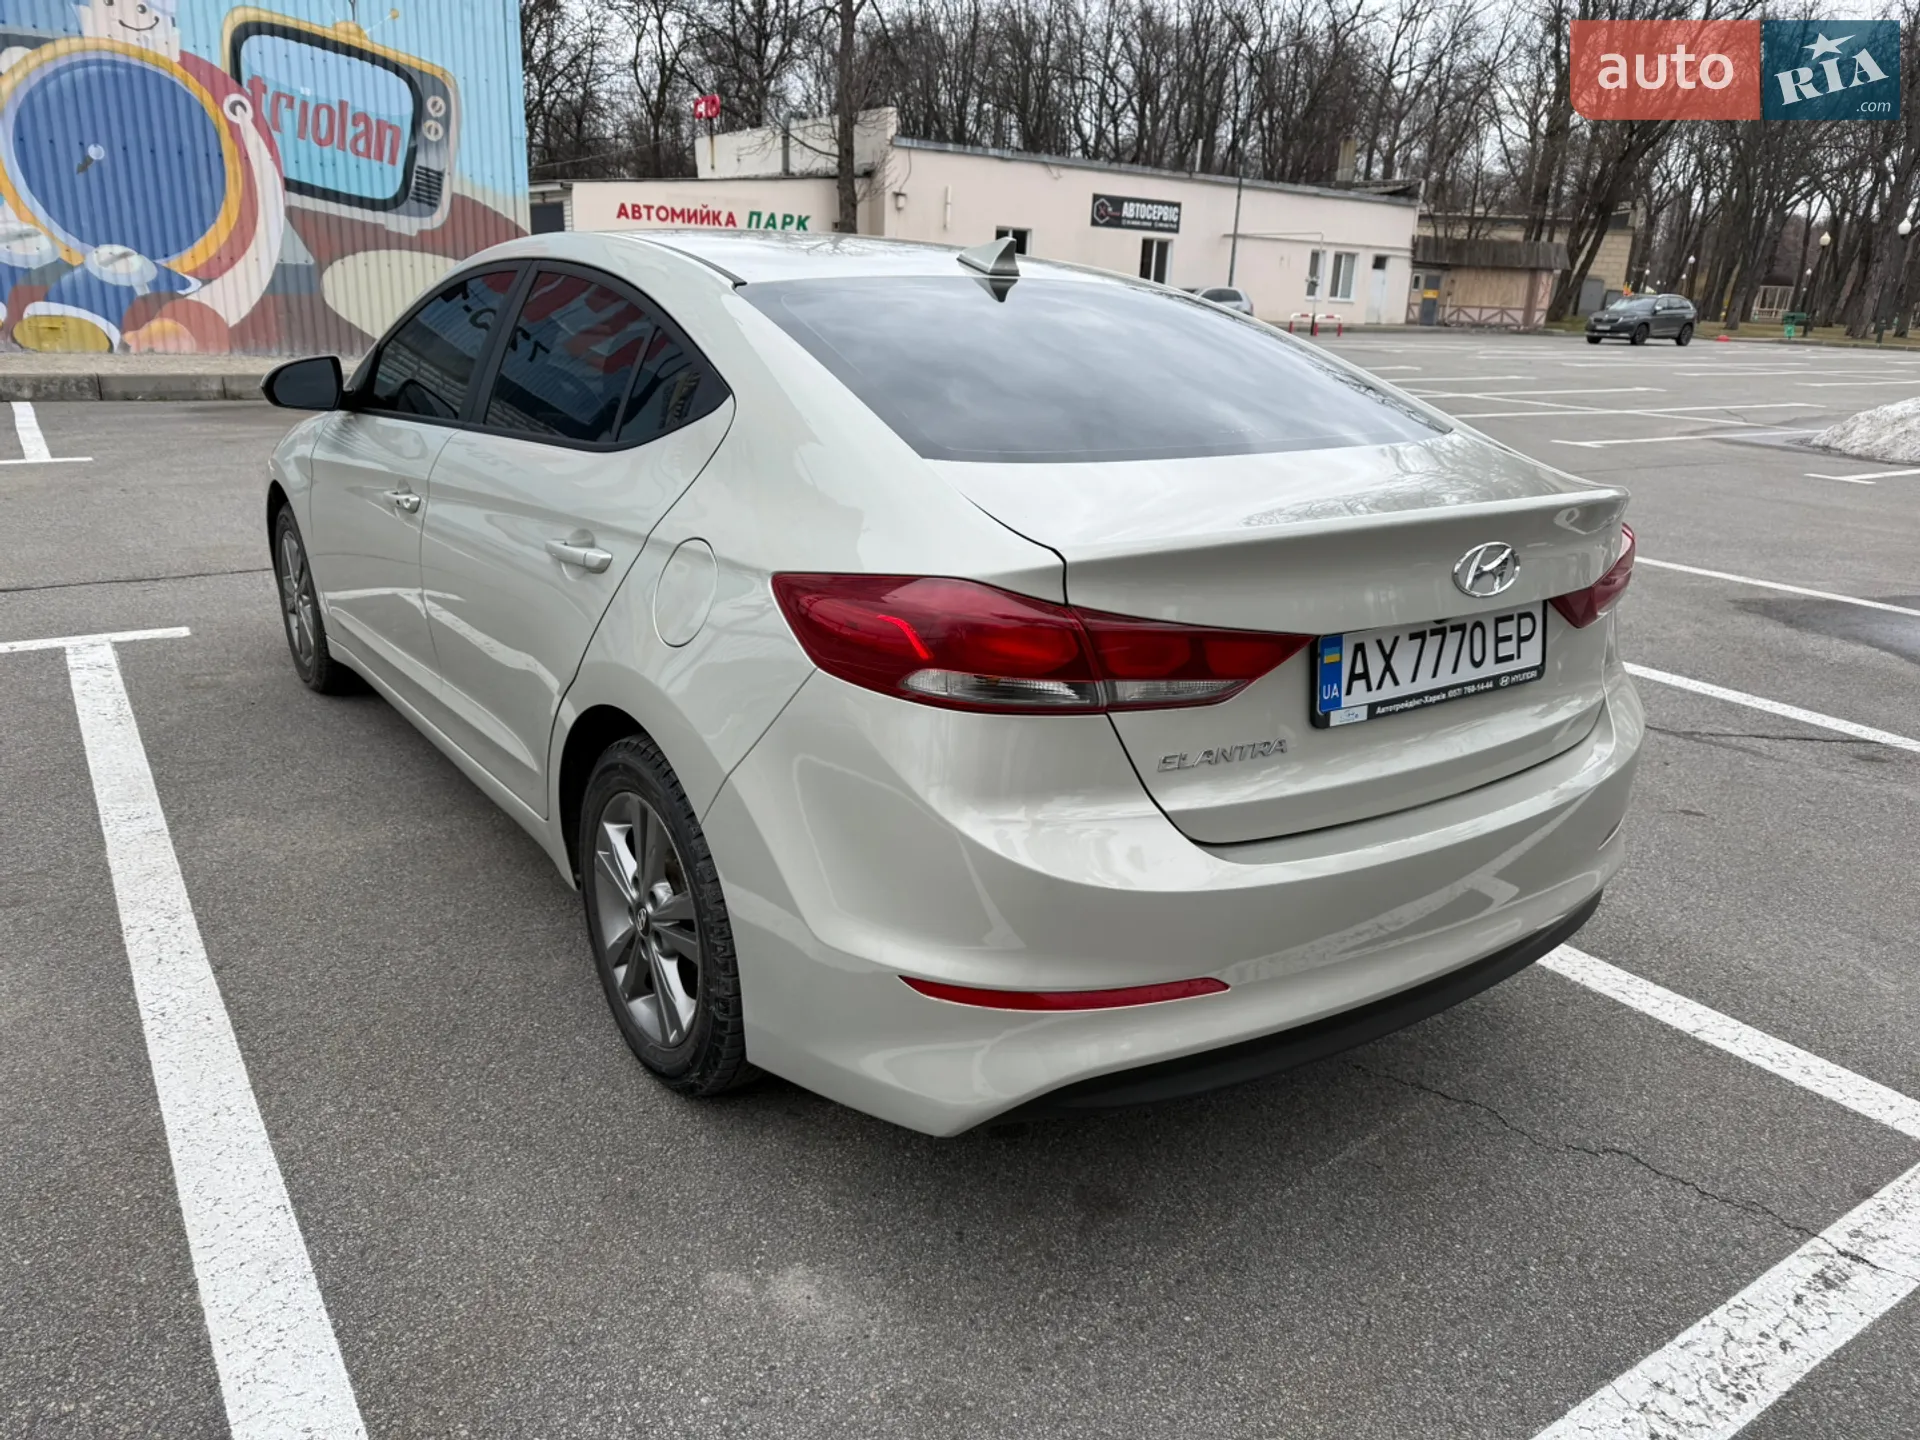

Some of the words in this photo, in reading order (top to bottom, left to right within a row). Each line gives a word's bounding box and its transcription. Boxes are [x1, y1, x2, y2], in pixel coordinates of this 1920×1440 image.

[247, 74, 402, 167] triolan
[616, 202, 738, 228] АВТОМИЙКА
[747, 210, 811, 231] ПАРК
[1122, 201, 1179, 222] АВТОСЕРВІС
[1510, 670, 1538, 685] HYUNDAI
[1322, 682, 1340, 700] UA
[1157, 738, 1287, 773] ELANTRA
